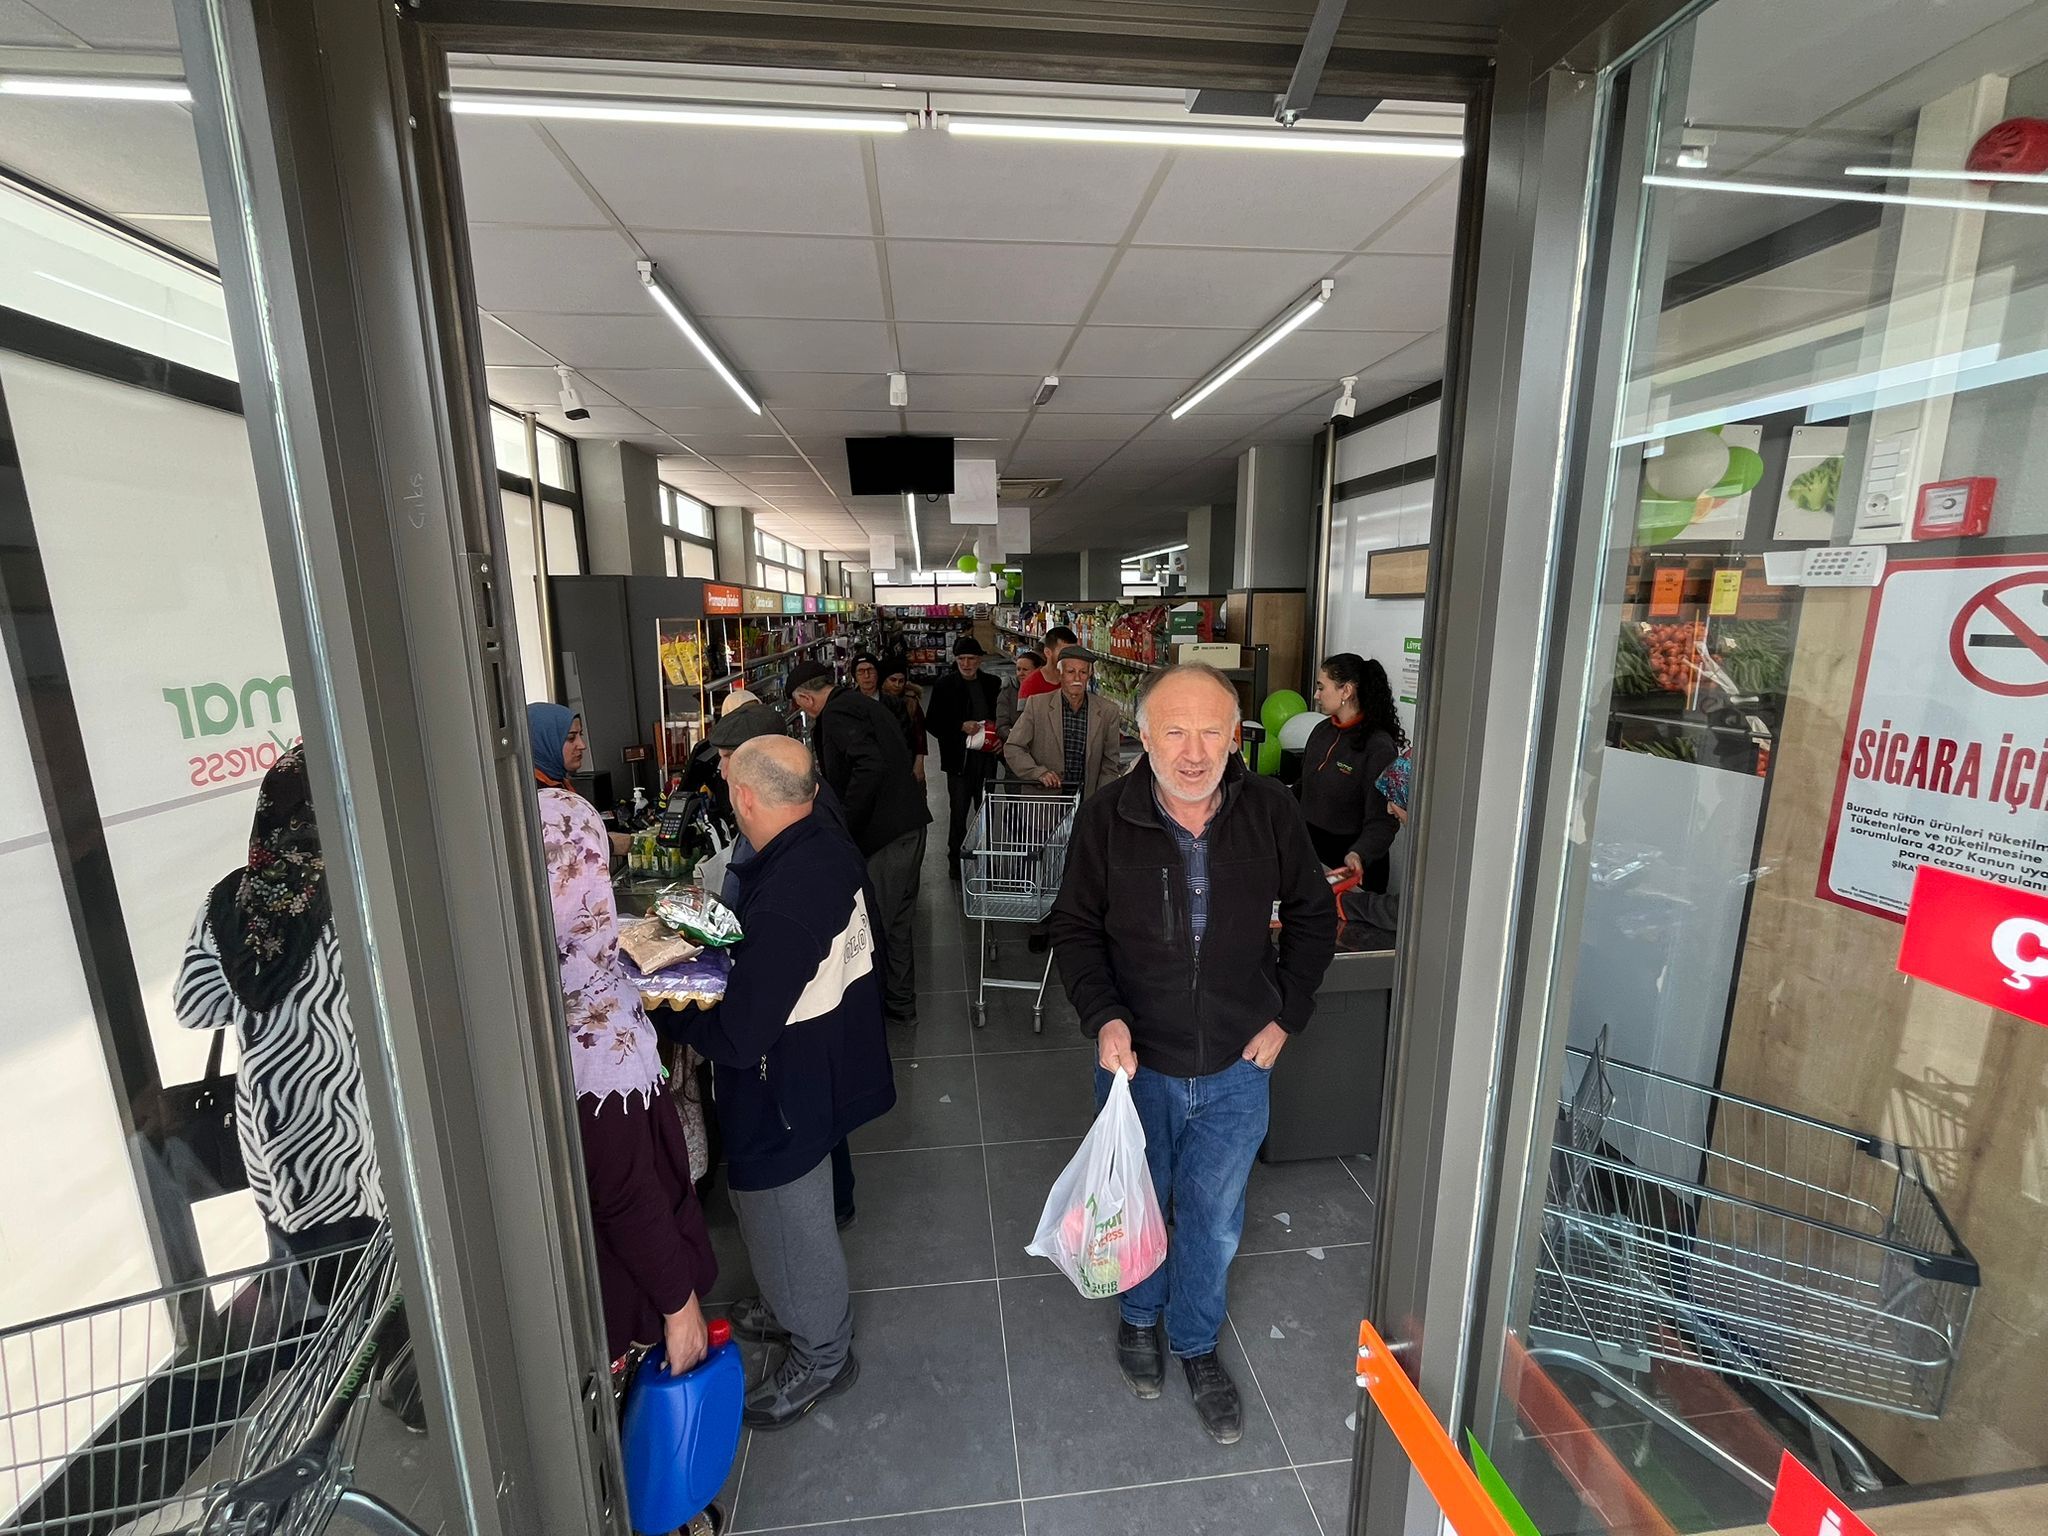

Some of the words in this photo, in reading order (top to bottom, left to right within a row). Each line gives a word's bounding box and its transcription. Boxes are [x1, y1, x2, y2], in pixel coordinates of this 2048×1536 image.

[1853, 719, 1982, 799] SİGARA
[1988, 733, 2048, 814] İÇİ
[1846, 802, 1889, 818] Burada
[1893, 812, 1925, 826] tütün
[1929, 819, 1984, 839] ürünleri
[1850, 813, 1921, 837] Tüketenlere
[1924, 831, 1940, 841] ve
[1944, 834, 2043, 864] tüketilmesine
[1850, 826, 1923, 849] sorumlulara
[1927, 843, 1963, 857] 4207
[1967, 851, 2015, 870] Kanun
[1892, 859, 1917, 872] ŞİKA
[1899, 849, 1930, 863] para
[1934, 856, 1975, 873] cezası
